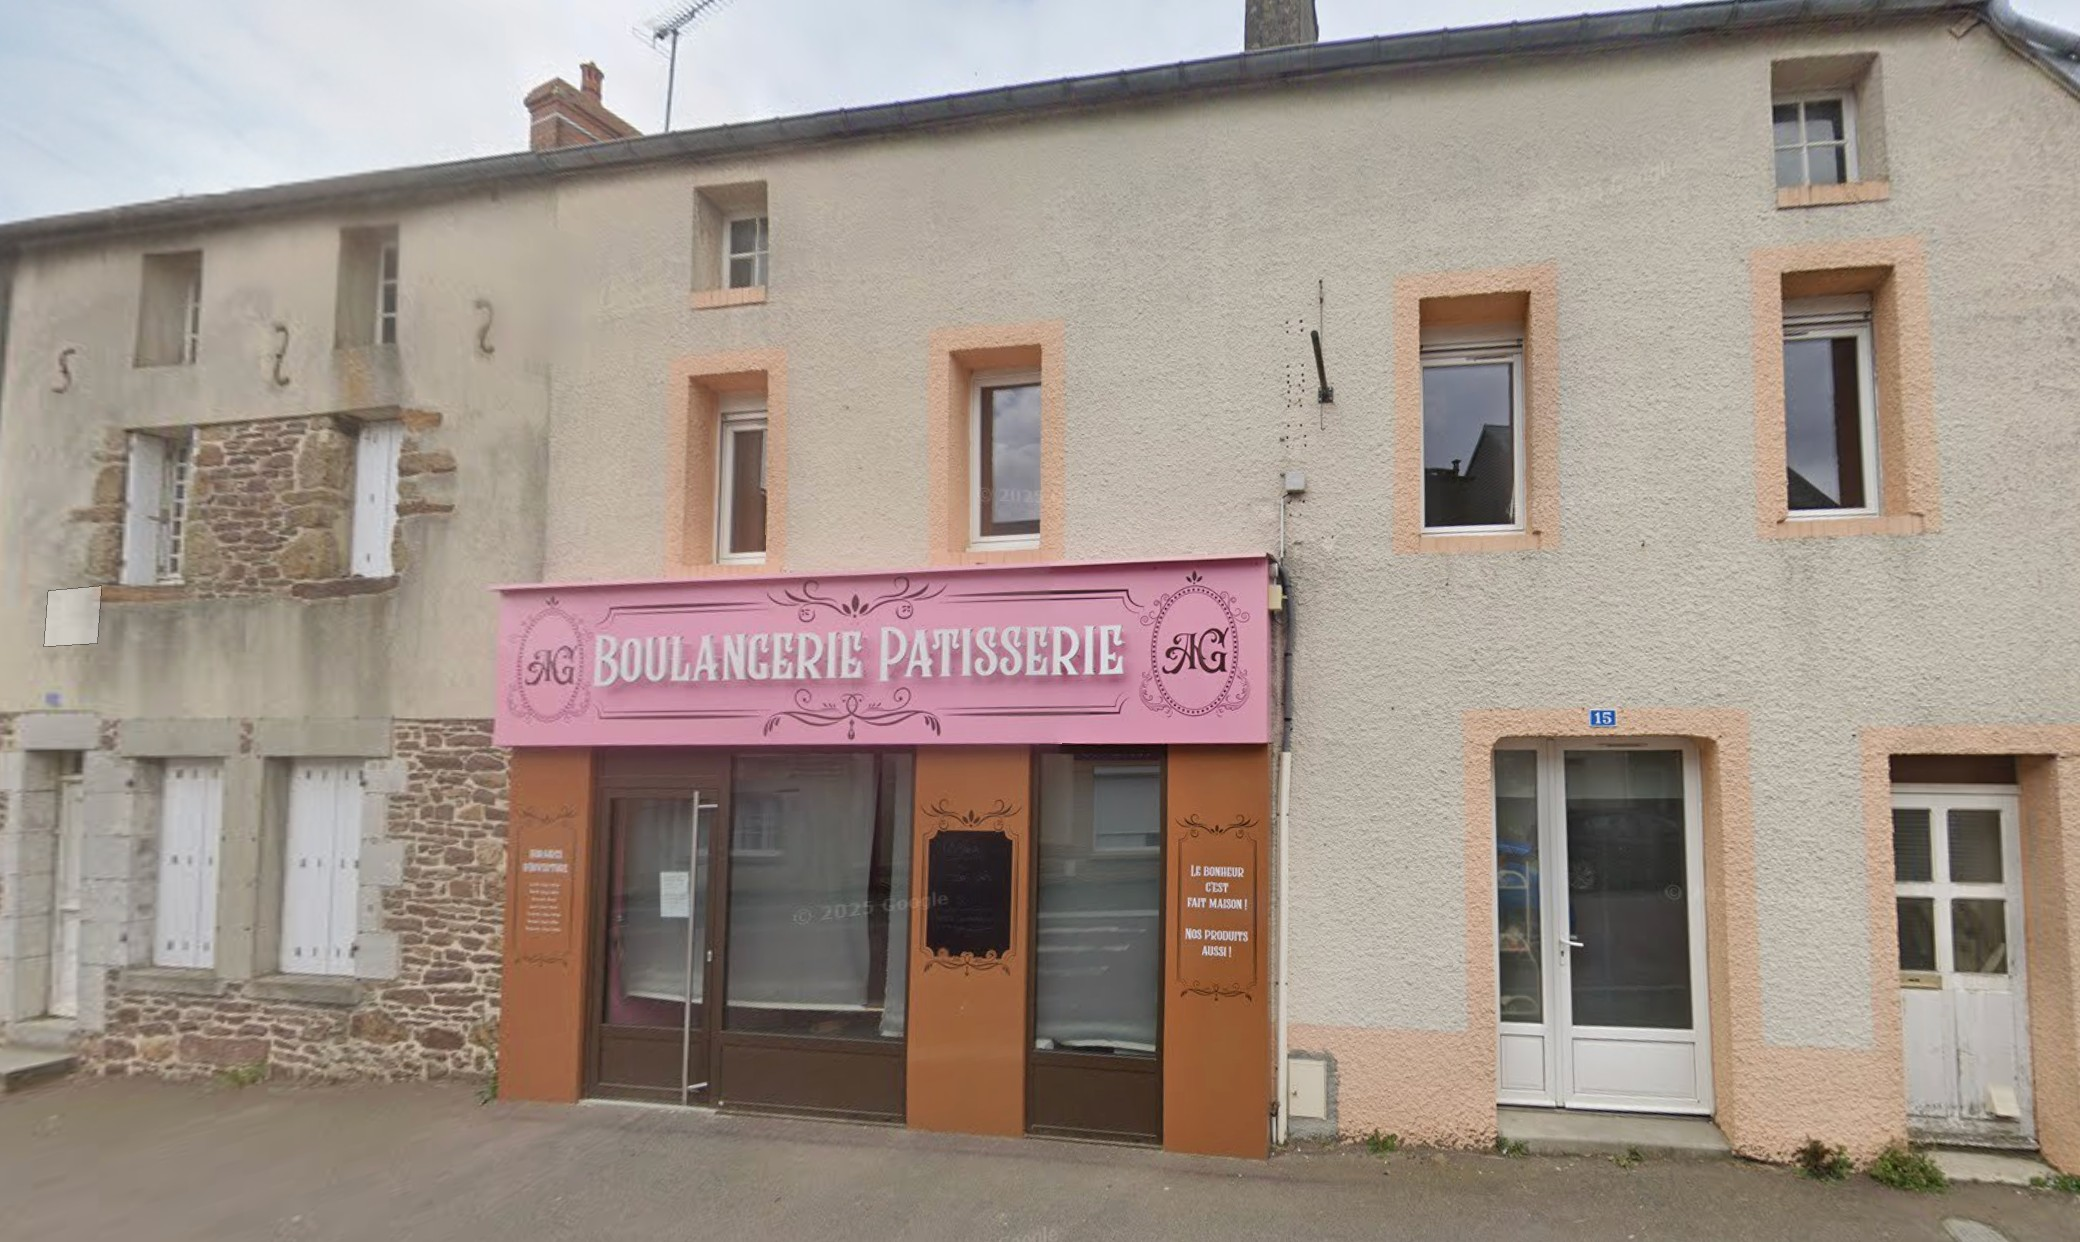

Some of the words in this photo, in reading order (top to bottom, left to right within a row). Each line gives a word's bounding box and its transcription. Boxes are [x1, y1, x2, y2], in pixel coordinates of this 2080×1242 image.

[593, 627, 864, 688] BOULANGERIE
[879, 624, 1125, 682] PATISSERIE
[1162, 626, 1229, 676] AG
[1595, 711, 1612, 725] 15
[1203, 866, 1244, 877] BONHEUR
[1187, 897, 1206, 908] FAIT
[1209, 898, 1242, 910] MAISON
[1204, 929, 1248, 942] PRODUITS
[1201, 945, 1227, 956] AUSSI
